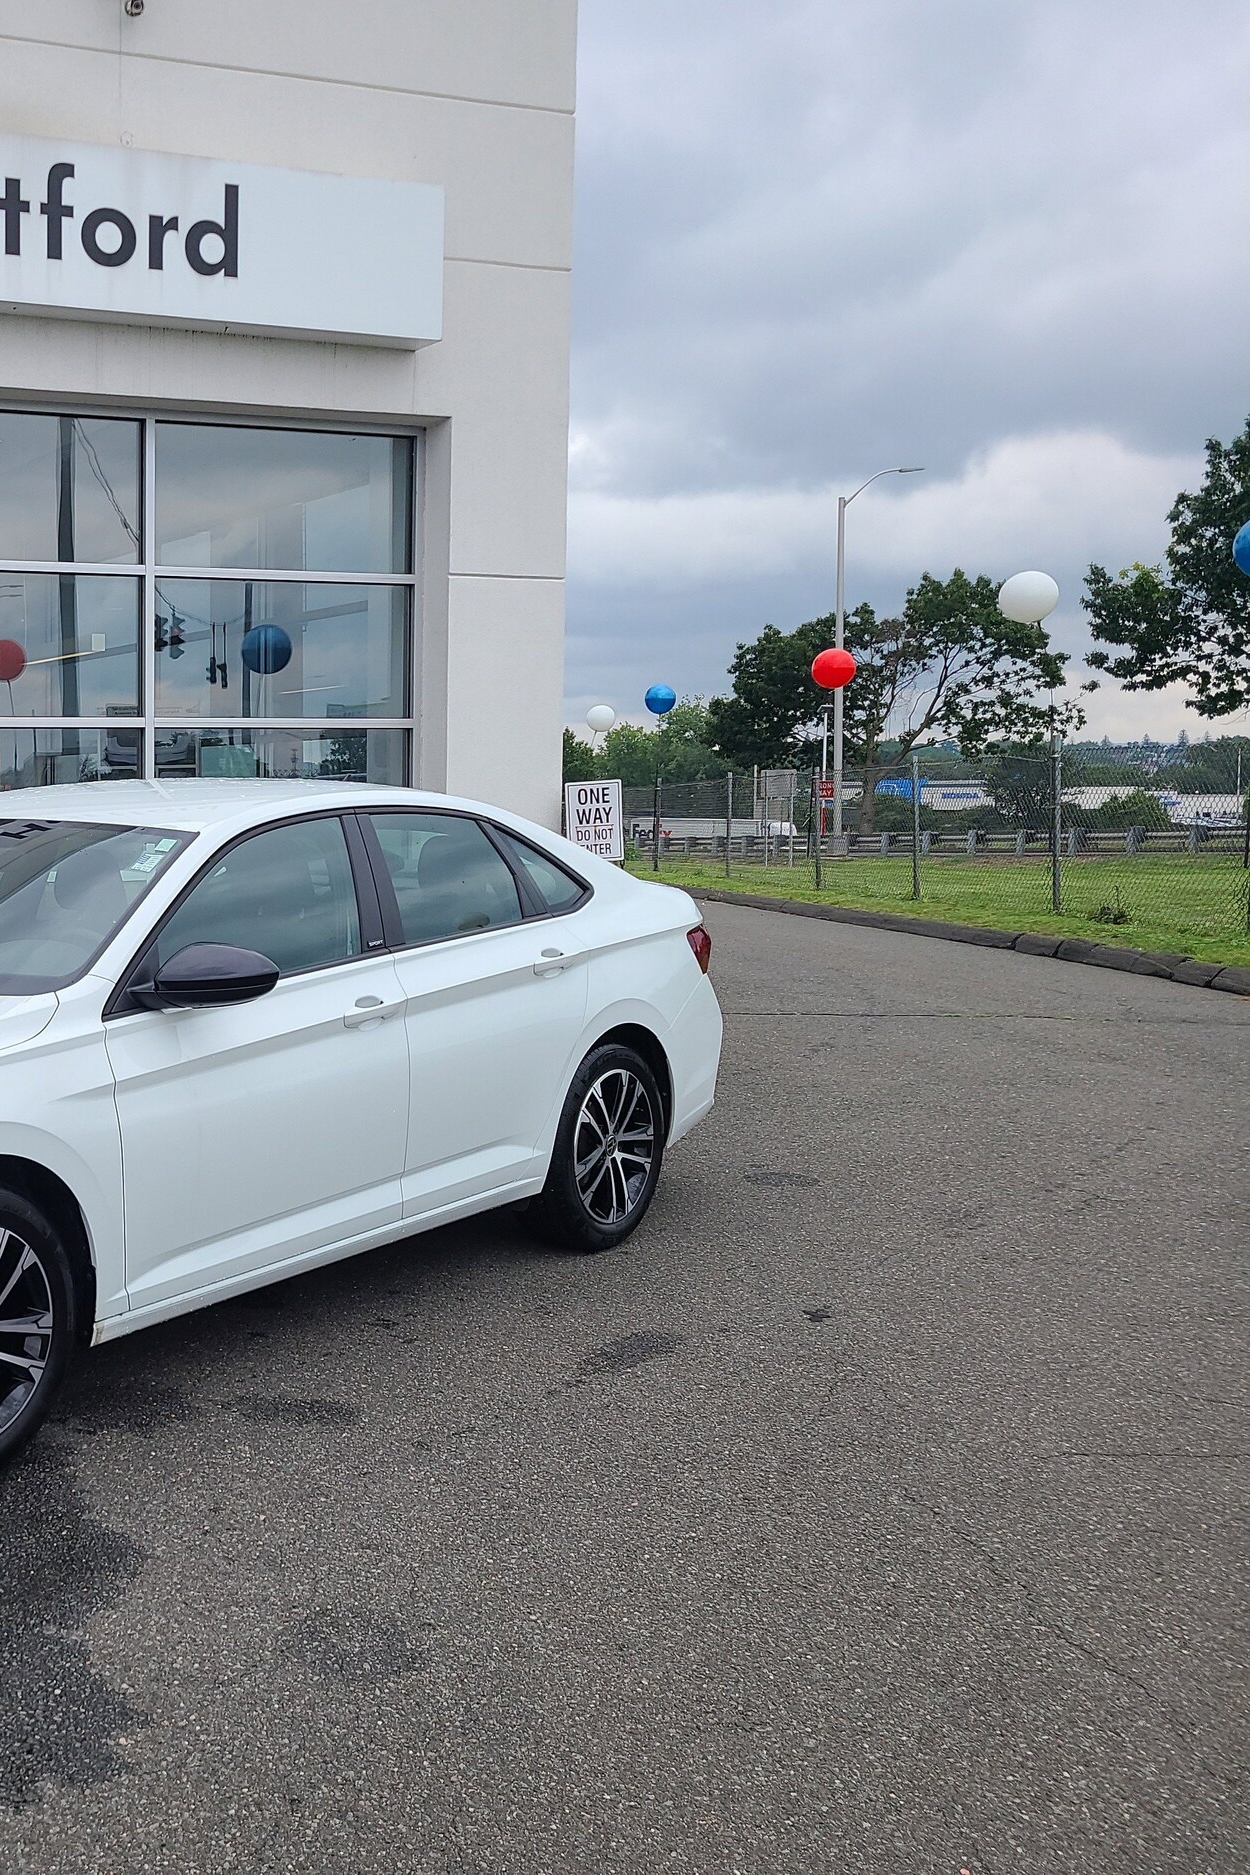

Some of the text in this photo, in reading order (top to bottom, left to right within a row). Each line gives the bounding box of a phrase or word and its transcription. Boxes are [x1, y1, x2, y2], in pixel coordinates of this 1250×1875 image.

[577, 786, 611, 806] ONE
[576, 806, 613, 825] WAY
[576, 828, 614, 842] DO NOT
[579, 842, 612, 855] NTER
